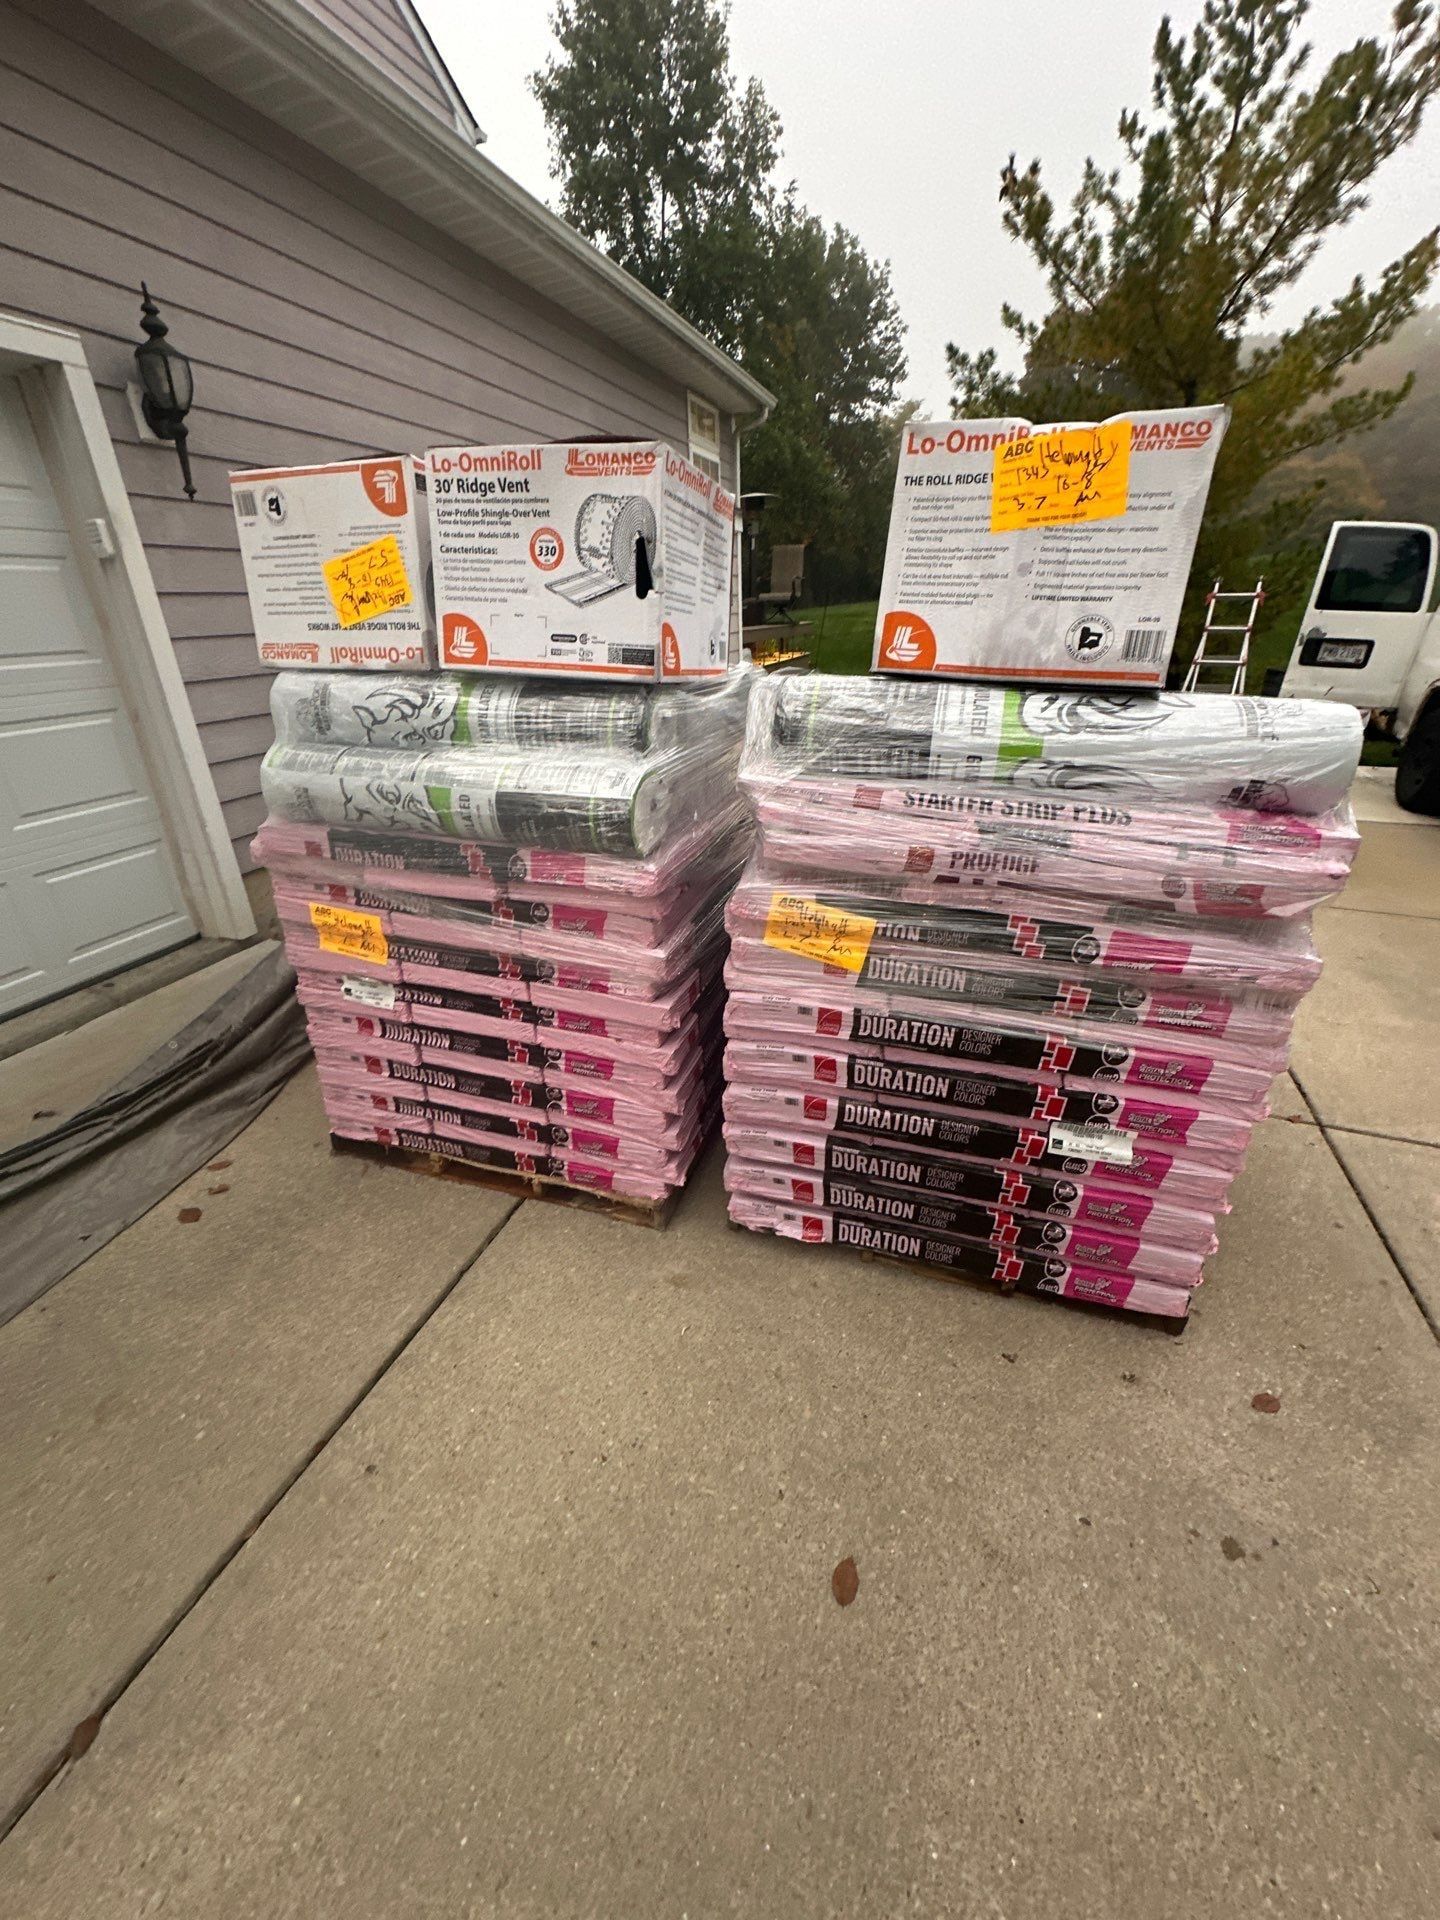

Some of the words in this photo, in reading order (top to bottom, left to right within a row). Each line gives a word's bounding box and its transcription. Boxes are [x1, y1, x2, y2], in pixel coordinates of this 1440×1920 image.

[1131, 419, 1212, 440] MANCO
[1003, 441, 1034, 459] ABC
[431, 448, 542, 473] Lo-OmniRoll
[568, 448, 656, 466] LOMANCO
[598, 466, 632, 476] VENTS
[456, 477, 495, 497] Ridge
[498, 477, 530, 493] Vent
[904, 476, 924, 486] THE
[926, 475, 952, 486] ROLL
[955, 473, 988, 484] RIDGE
[437, 509, 479, 518] Low-Profile
[480, 509, 531, 519] Shingle-Over
[532, 509, 550, 517] Vent
[537, 546, 556, 557] 330
[388, 591, 404, 606] ABC
[329, 646, 424, 662] Lo-OmniRoll
[875, 922, 920, 942] TION
[389, 945, 440, 965] RATION
[867, 957, 966, 992] DURATION
[395, 988, 443, 1004] RATION
[971, 983, 1006, 998] COLORS
[385, 1024, 450, 1048] DURATION
[858, 1015, 956, 1048] DURATION
[963, 1029, 1002, 1046] DESIGNER
[959, 1040, 992, 1055] COLORS
[393, 1064, 456, 1089] DURATION
[854, 1064, 950, 1098] DURATION
[955, 1080, 997, 1096] DESIGNER
[1139, 1074, 1190, 1086] PROTECTION
[953, 1091, 987, 1106] COLORS
[399, 1103, 462, 1125] DURATION
[843, 1104, 935, 1137] DURATION
[941, 1120, 980, 1136] DESIGNER
[1128, 1122, 1175, 1135] PROTECTION
[939, 1130, 970, 1145] COLORS
[832, 1151, 921, 1183] DURATION
[927, 1168, 965, 1182] DESIGNER
[1105, 1164, 1151, 1178] PROTECTION
[925, 1177, 956, 1190] COLORS
[830, 1188, 915, 1219] DURATION
[920, 1206, 956, 1221] DESIGNER
[919, 1215, 948, 1228] COLORS
[1087, 1210, 1131, 1225] PROTECTION
[839, 1224, 920, 1256] DURATION
[926, 1241, 961, 1256] DESIGNER
[925, 1250, 952, 1264] COLORS
[1074, 1286, 1116, 1299] PROTECTION
